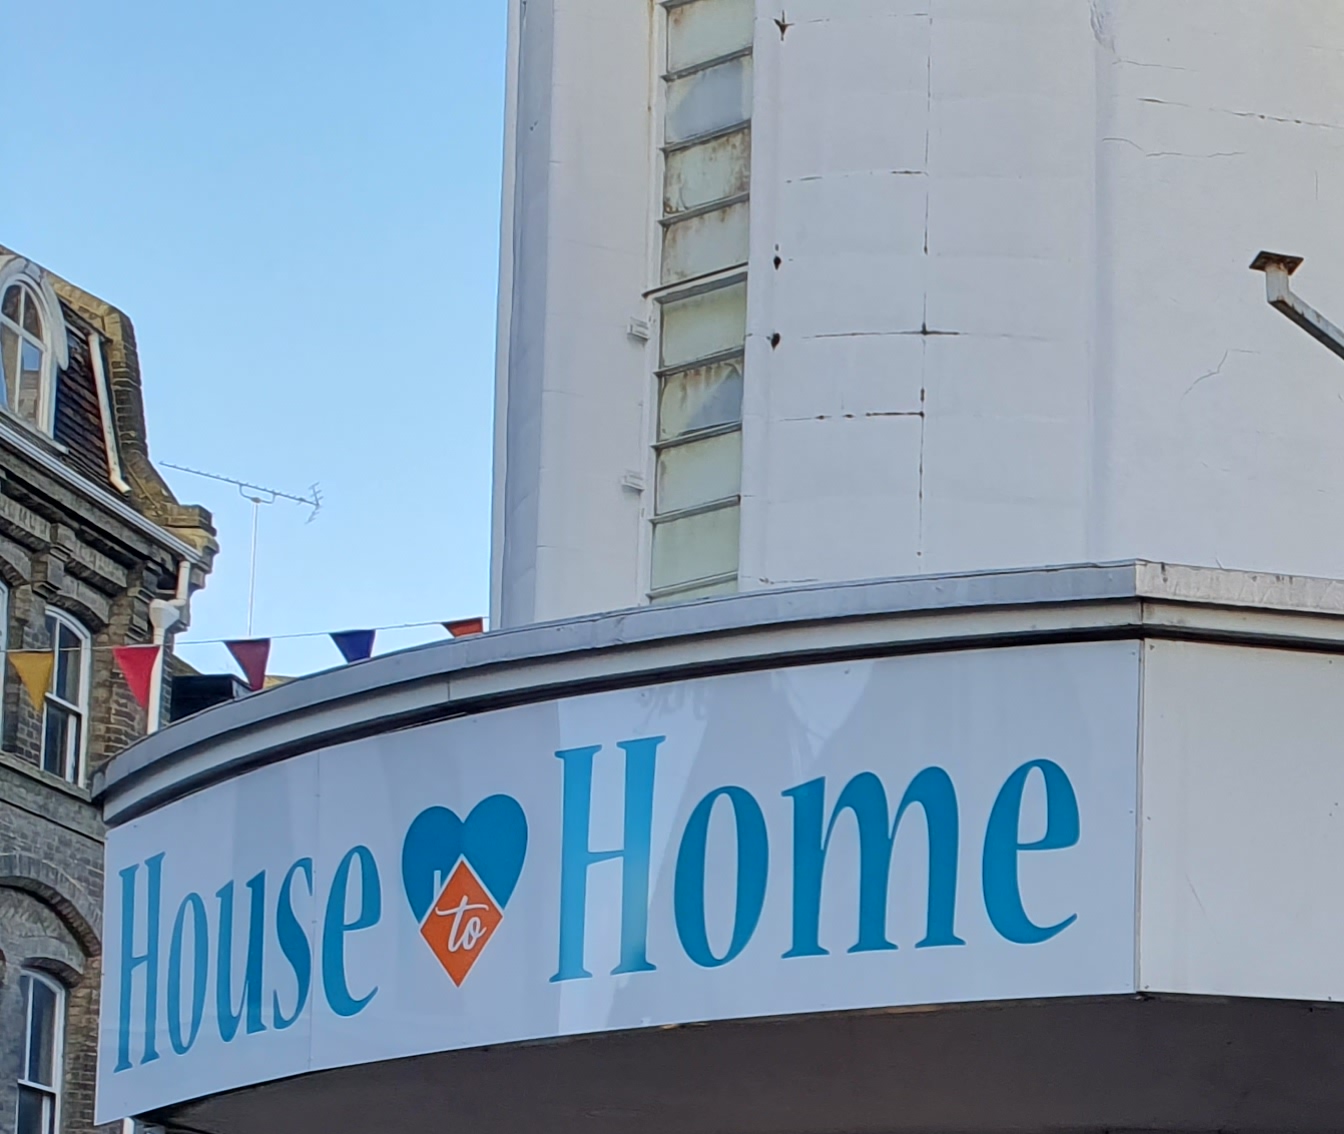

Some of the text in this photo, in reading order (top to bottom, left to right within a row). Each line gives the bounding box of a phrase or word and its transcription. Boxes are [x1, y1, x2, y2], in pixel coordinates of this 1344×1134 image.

[112, 734, 1081, 1074] House to Home
